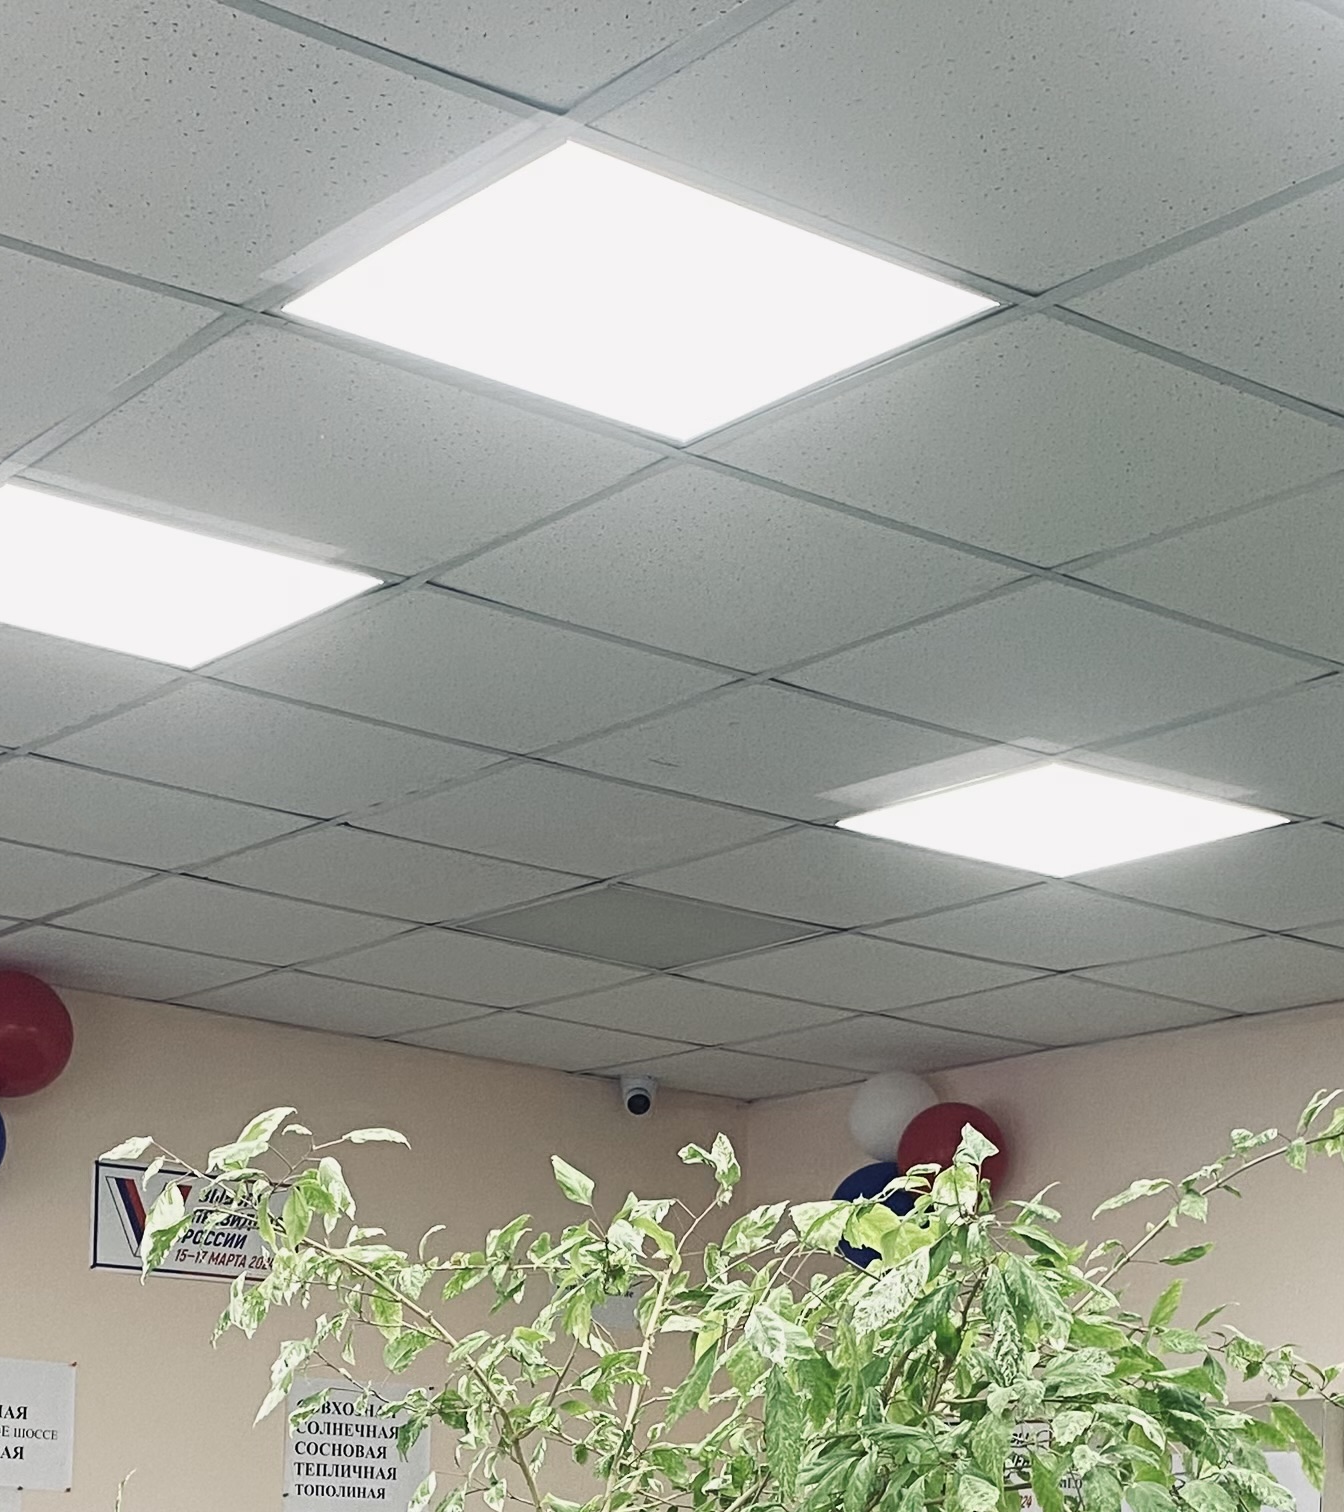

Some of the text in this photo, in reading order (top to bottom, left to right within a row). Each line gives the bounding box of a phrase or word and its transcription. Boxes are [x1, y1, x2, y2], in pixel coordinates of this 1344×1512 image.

[181, 1229, 247, 1249] РОССИИ
[208, 1252, 247, 1268] МАРТА
[13, 1427, 58, 1441] ШОССЕ
[295, 1441, 387, 1459] СОСНОВАЯ
[294, 1462, 397, 1480] ТЕПЛИЧНАЯ
[295, 1484, 385, 1499] ТОПОЛИНАЯ
